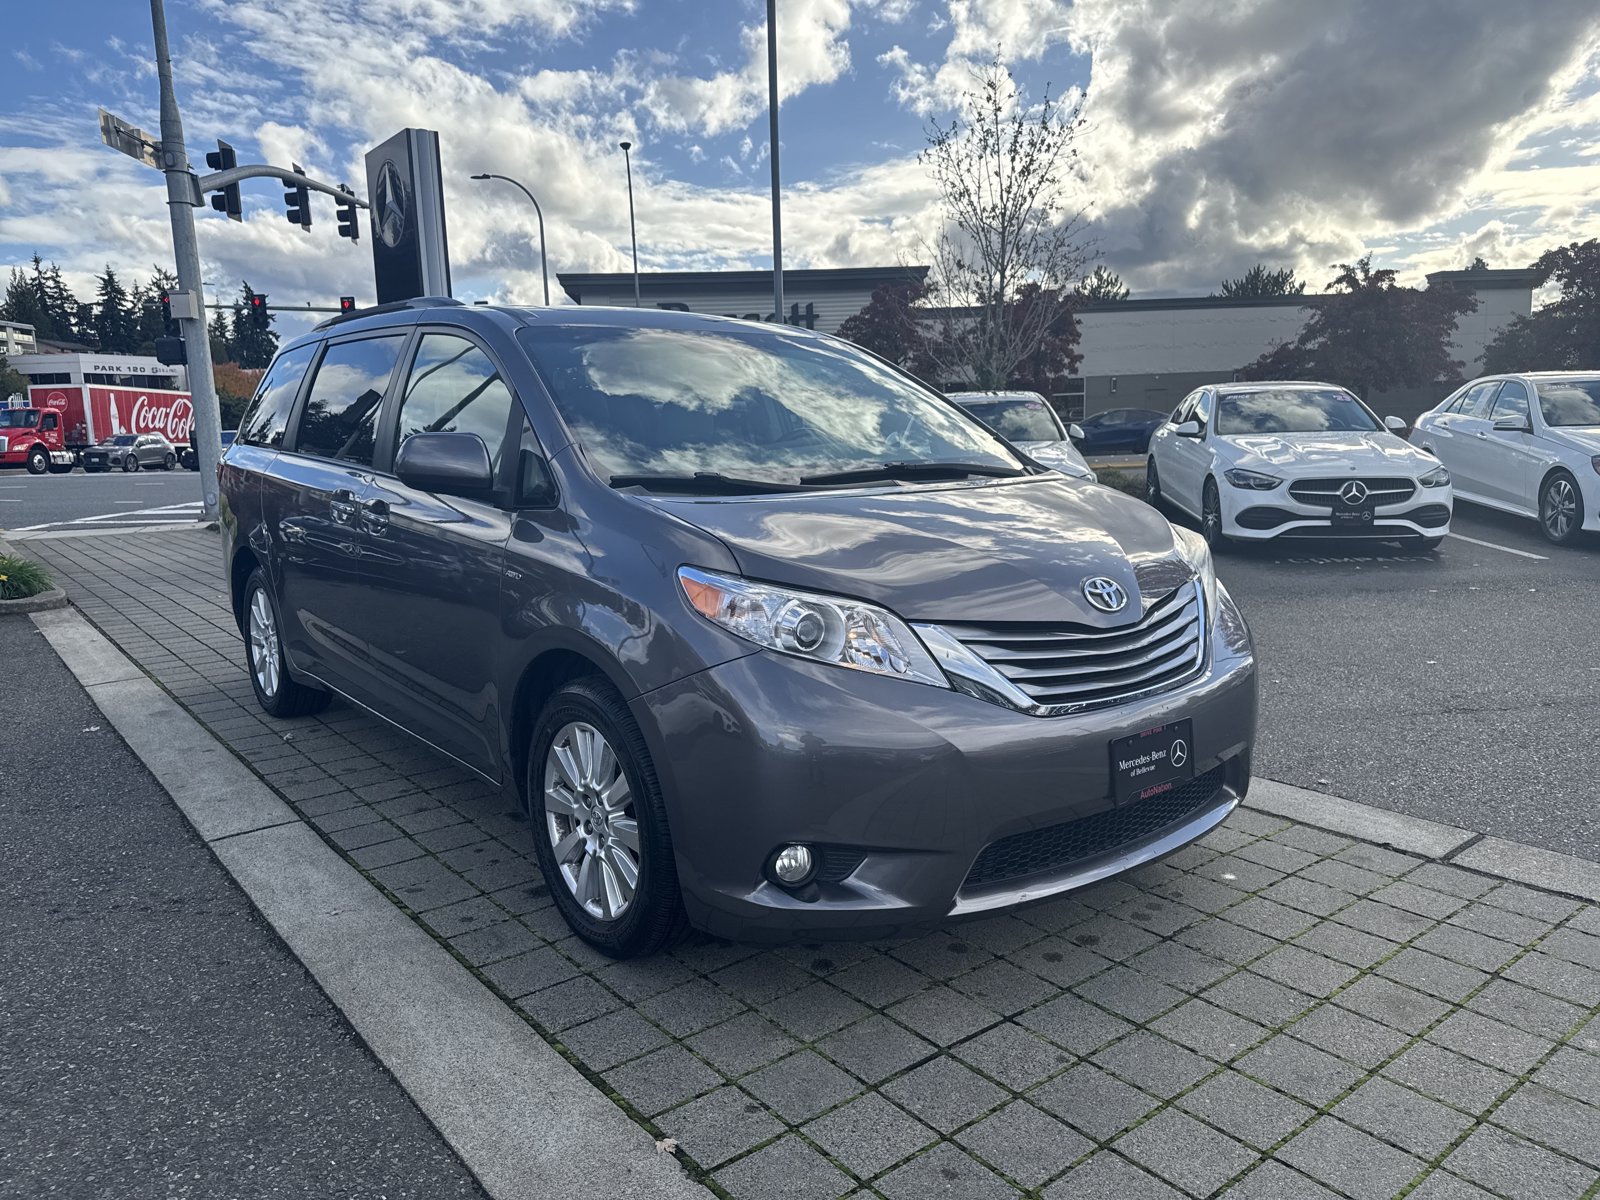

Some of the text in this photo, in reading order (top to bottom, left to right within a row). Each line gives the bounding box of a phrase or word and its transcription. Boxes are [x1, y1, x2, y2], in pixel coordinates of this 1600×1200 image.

[1119, 749, 1167, 771] Mercedes-Benz
[1130, 764, 1156, 777] of Bellevue
[1140, 782, 1173, 799] AutoNation
